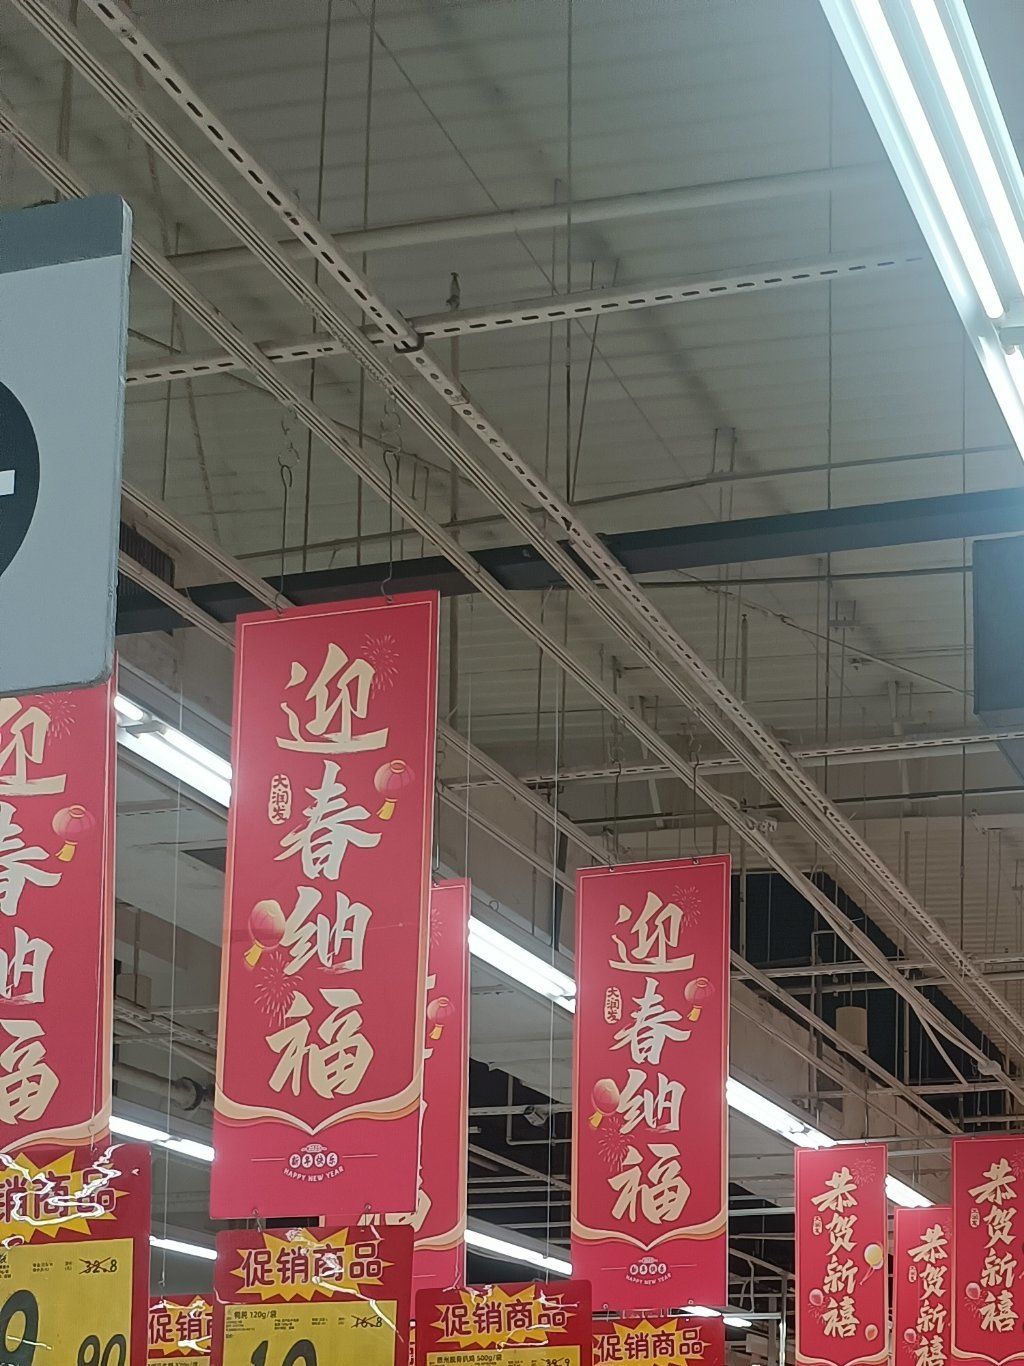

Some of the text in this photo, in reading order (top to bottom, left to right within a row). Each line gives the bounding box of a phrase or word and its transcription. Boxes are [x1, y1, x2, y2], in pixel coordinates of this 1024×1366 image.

[266, 641, 388, 1099] 迎春纳福
[608, 890, 696, 1224] 迎春纳福
[284, 1166, 344, 1182] HAPPY NEW YEAR
[810, 1166, 861, 1339] 恭贺新禧
[968, 1158, 1019, 1333] 恭贺新禧
[441, 1297, 567, 1337] 促销商品
[598, 1328, 703, 1362] 促销商品
